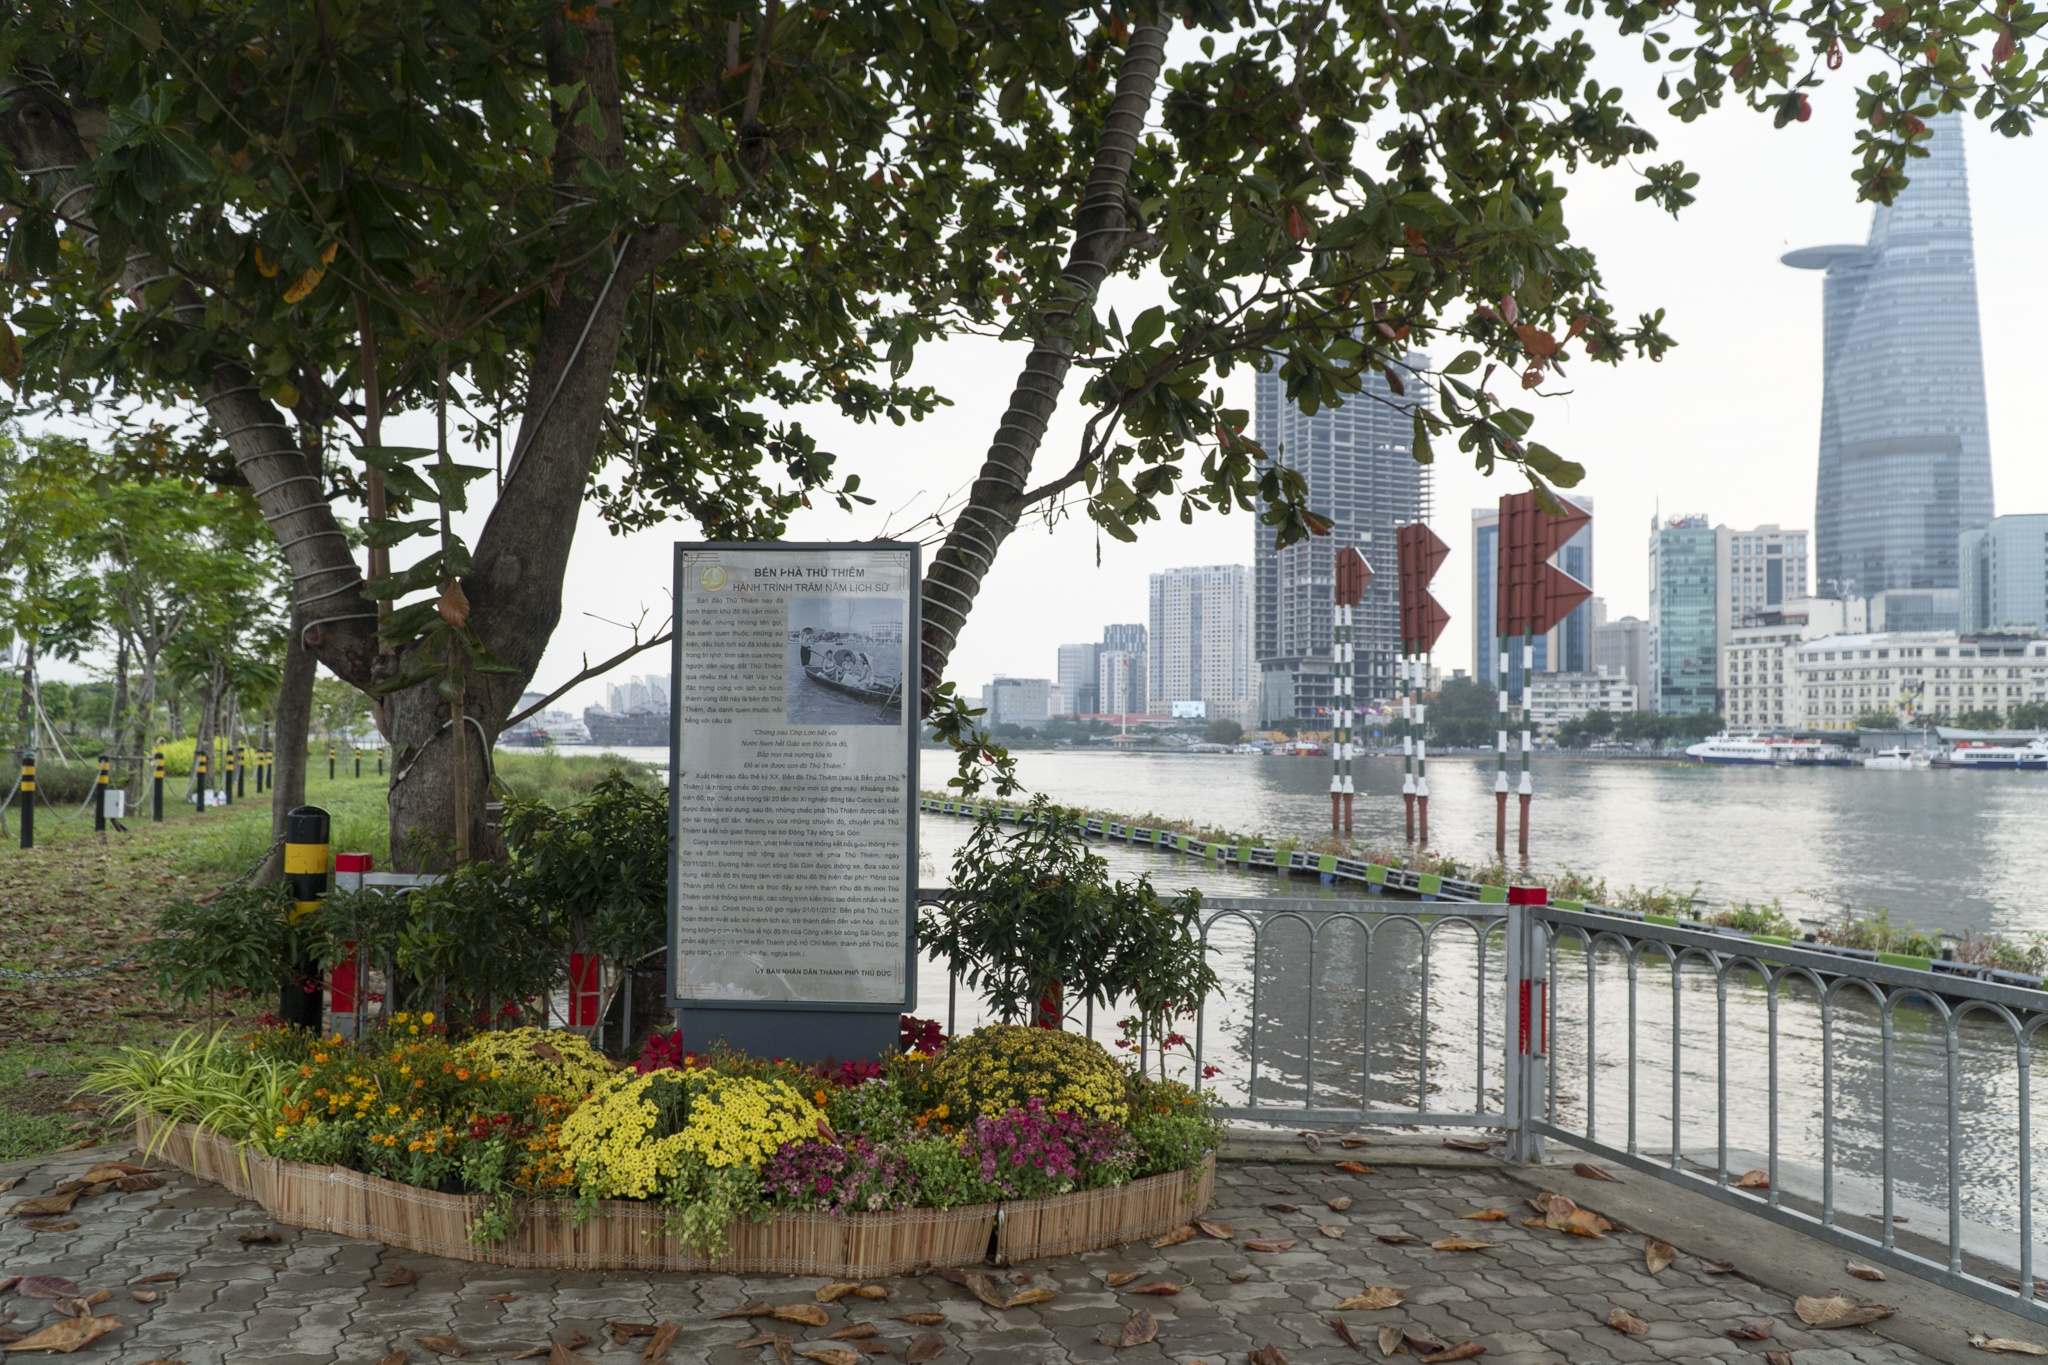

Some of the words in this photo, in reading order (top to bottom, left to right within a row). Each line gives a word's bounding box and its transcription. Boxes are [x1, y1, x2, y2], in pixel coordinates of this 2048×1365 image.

[755, 568, 777, 577] BẾN
[780, 568, 803, 577] PHÀ
[806, 568, 828, 577] THỦ
[832, 568, 864, 577] THIÊM
[733, 583, 760, 592] HÀNH
[764, 583, 792, 592] TRÌNH
[796, 583, 822, 592] TRĂM
[825, 583, 847, 592] NĂM
[850, 584, 872, 594] LỊCH
[875, 583, 890, 592] SỬ
